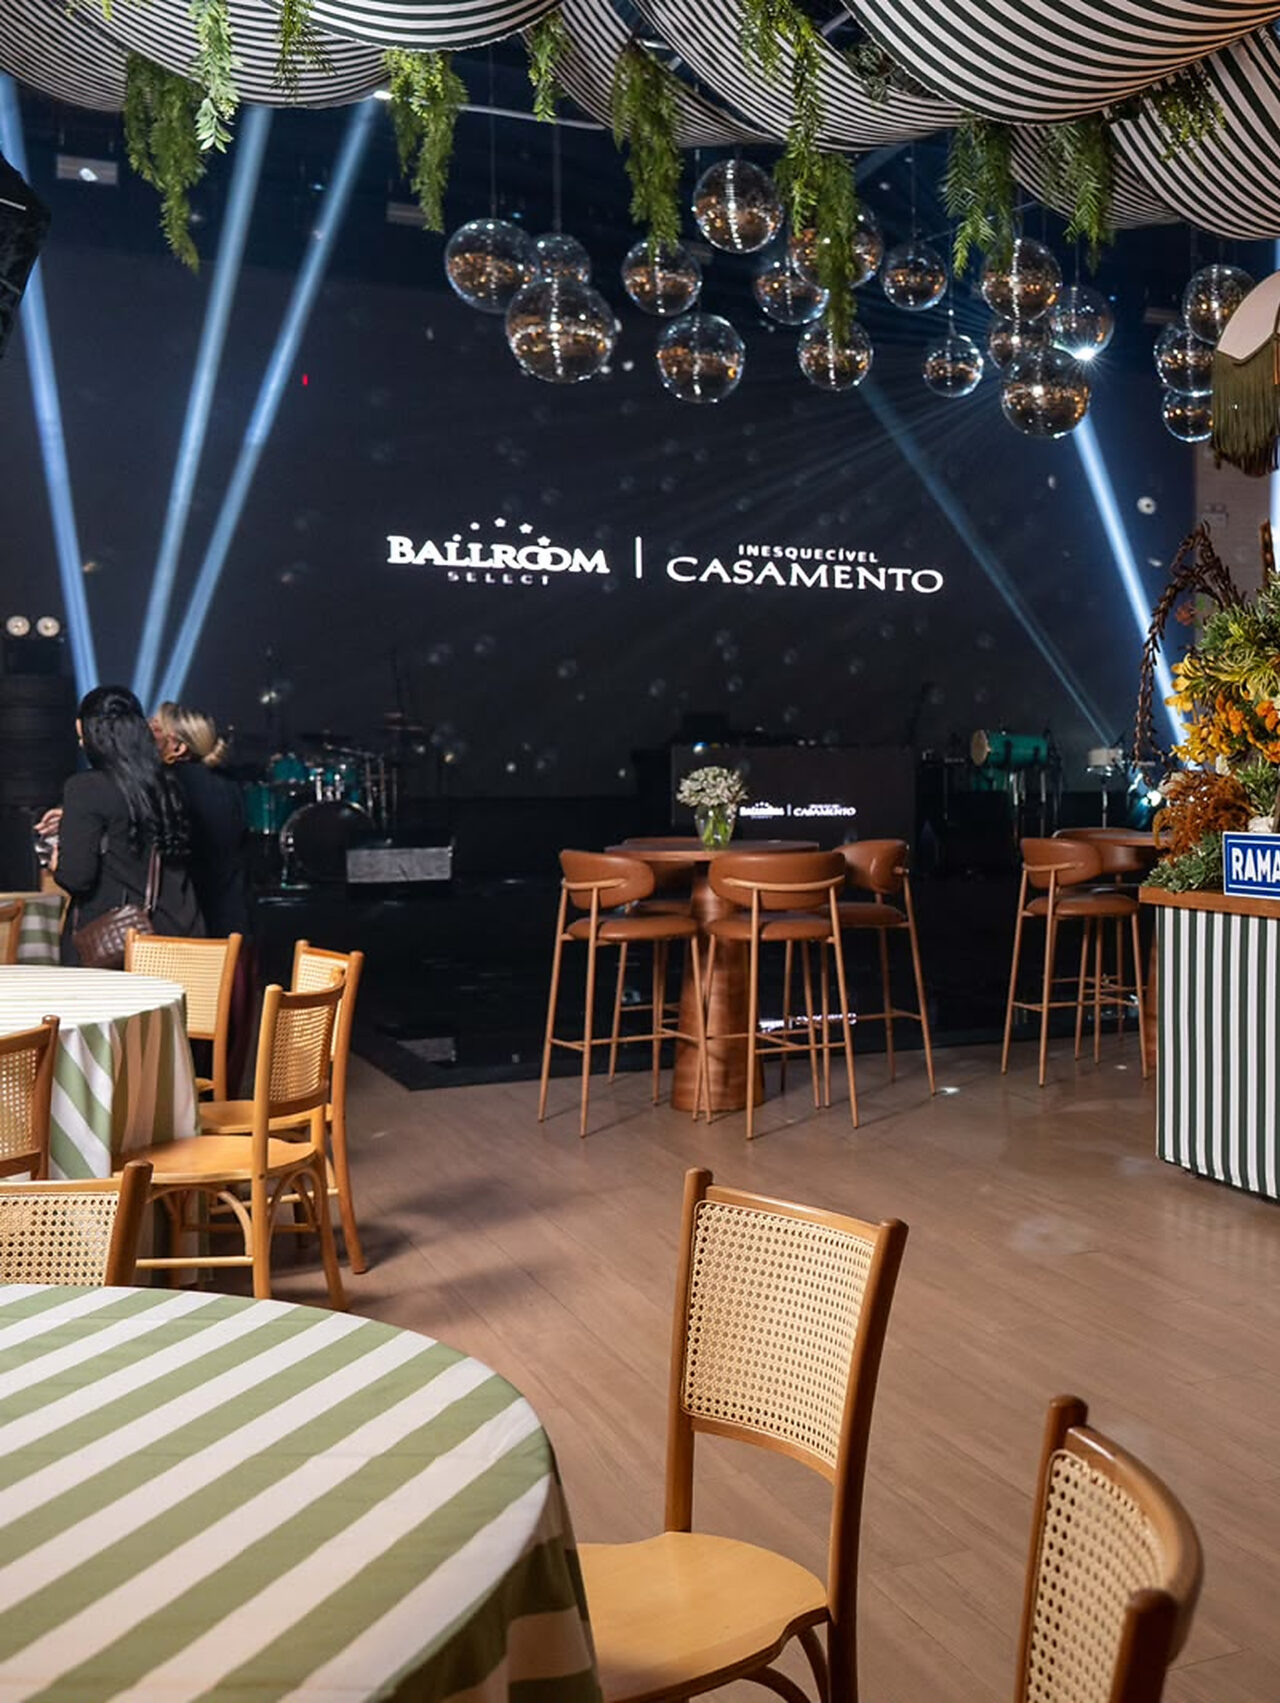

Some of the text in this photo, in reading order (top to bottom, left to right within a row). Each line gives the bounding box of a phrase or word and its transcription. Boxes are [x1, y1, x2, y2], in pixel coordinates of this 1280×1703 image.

[387, 535, 611, 574] BALLROOM
[738, 544, 879, 563] INESQUECÍVEL
[447, 571, 550, 585] SELECT
[667, 556, 944, 593] CASAMENTO
